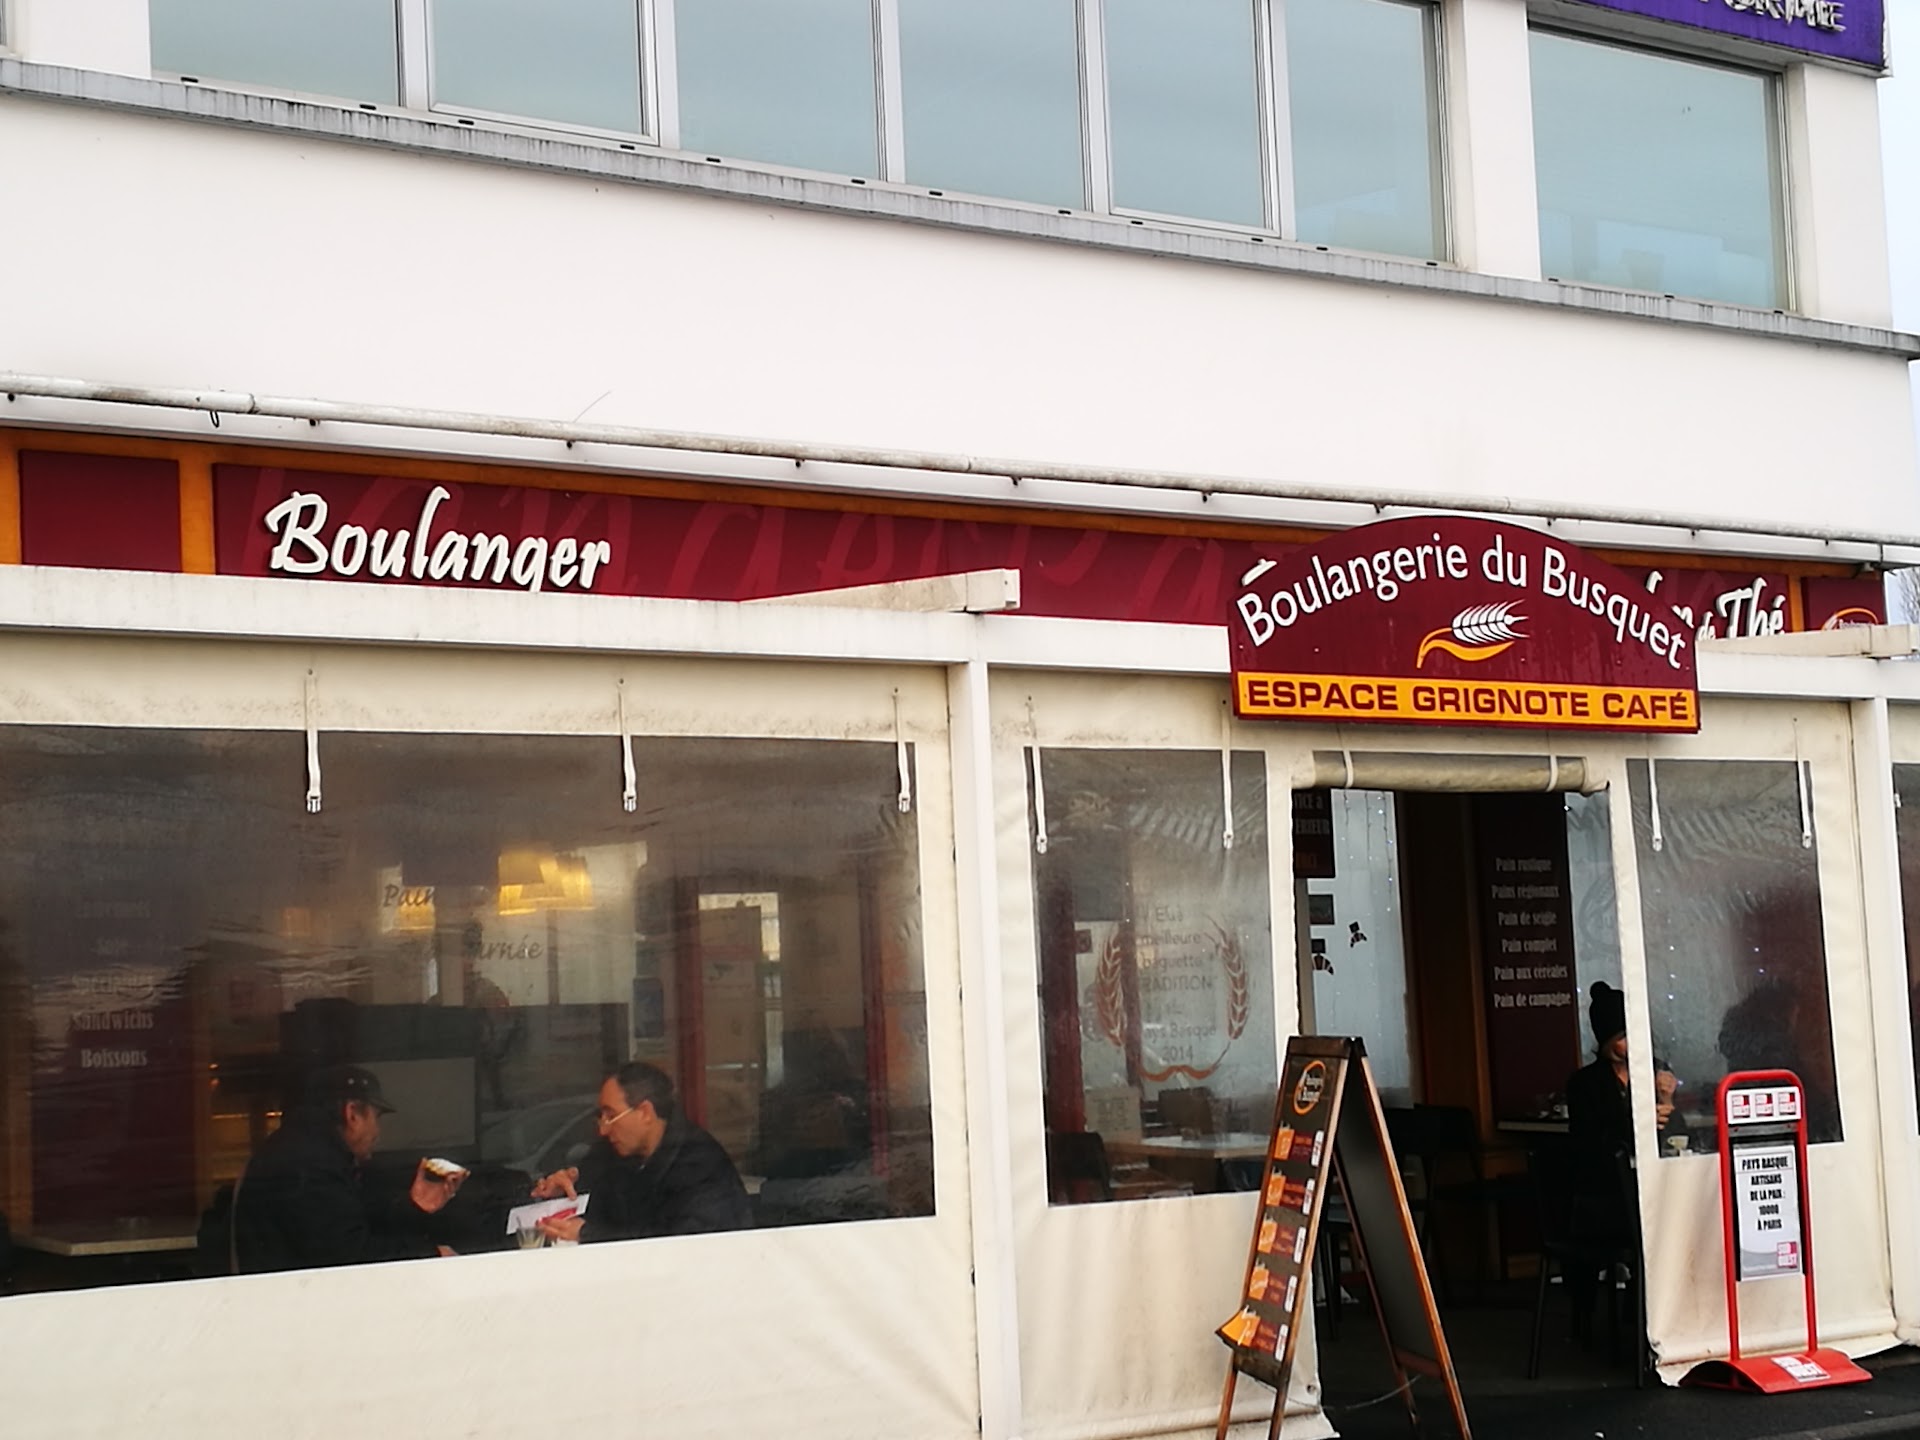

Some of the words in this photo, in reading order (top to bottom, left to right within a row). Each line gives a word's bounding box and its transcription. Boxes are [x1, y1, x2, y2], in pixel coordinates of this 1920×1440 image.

[263, 486, 611, 592] Boulanger
[1237, 532, 1469, 647] Boulangerie
[1481, 533, 1528, 588] du
[1542, 546, 1686, 669] Busquet
[1716, 577, 1786, 638] Thé
[1247, 680, 1399, 711] ESPACE
[1412, 686, 1590, 717] GRIGNOTE
[1602, 691, 1689, 721] CAFÉ
[1494, 966, 1514, 981] Pain
[1494, 993, 1514, 1009] Pain
[80, 1048, 148, 1069] Boissons
